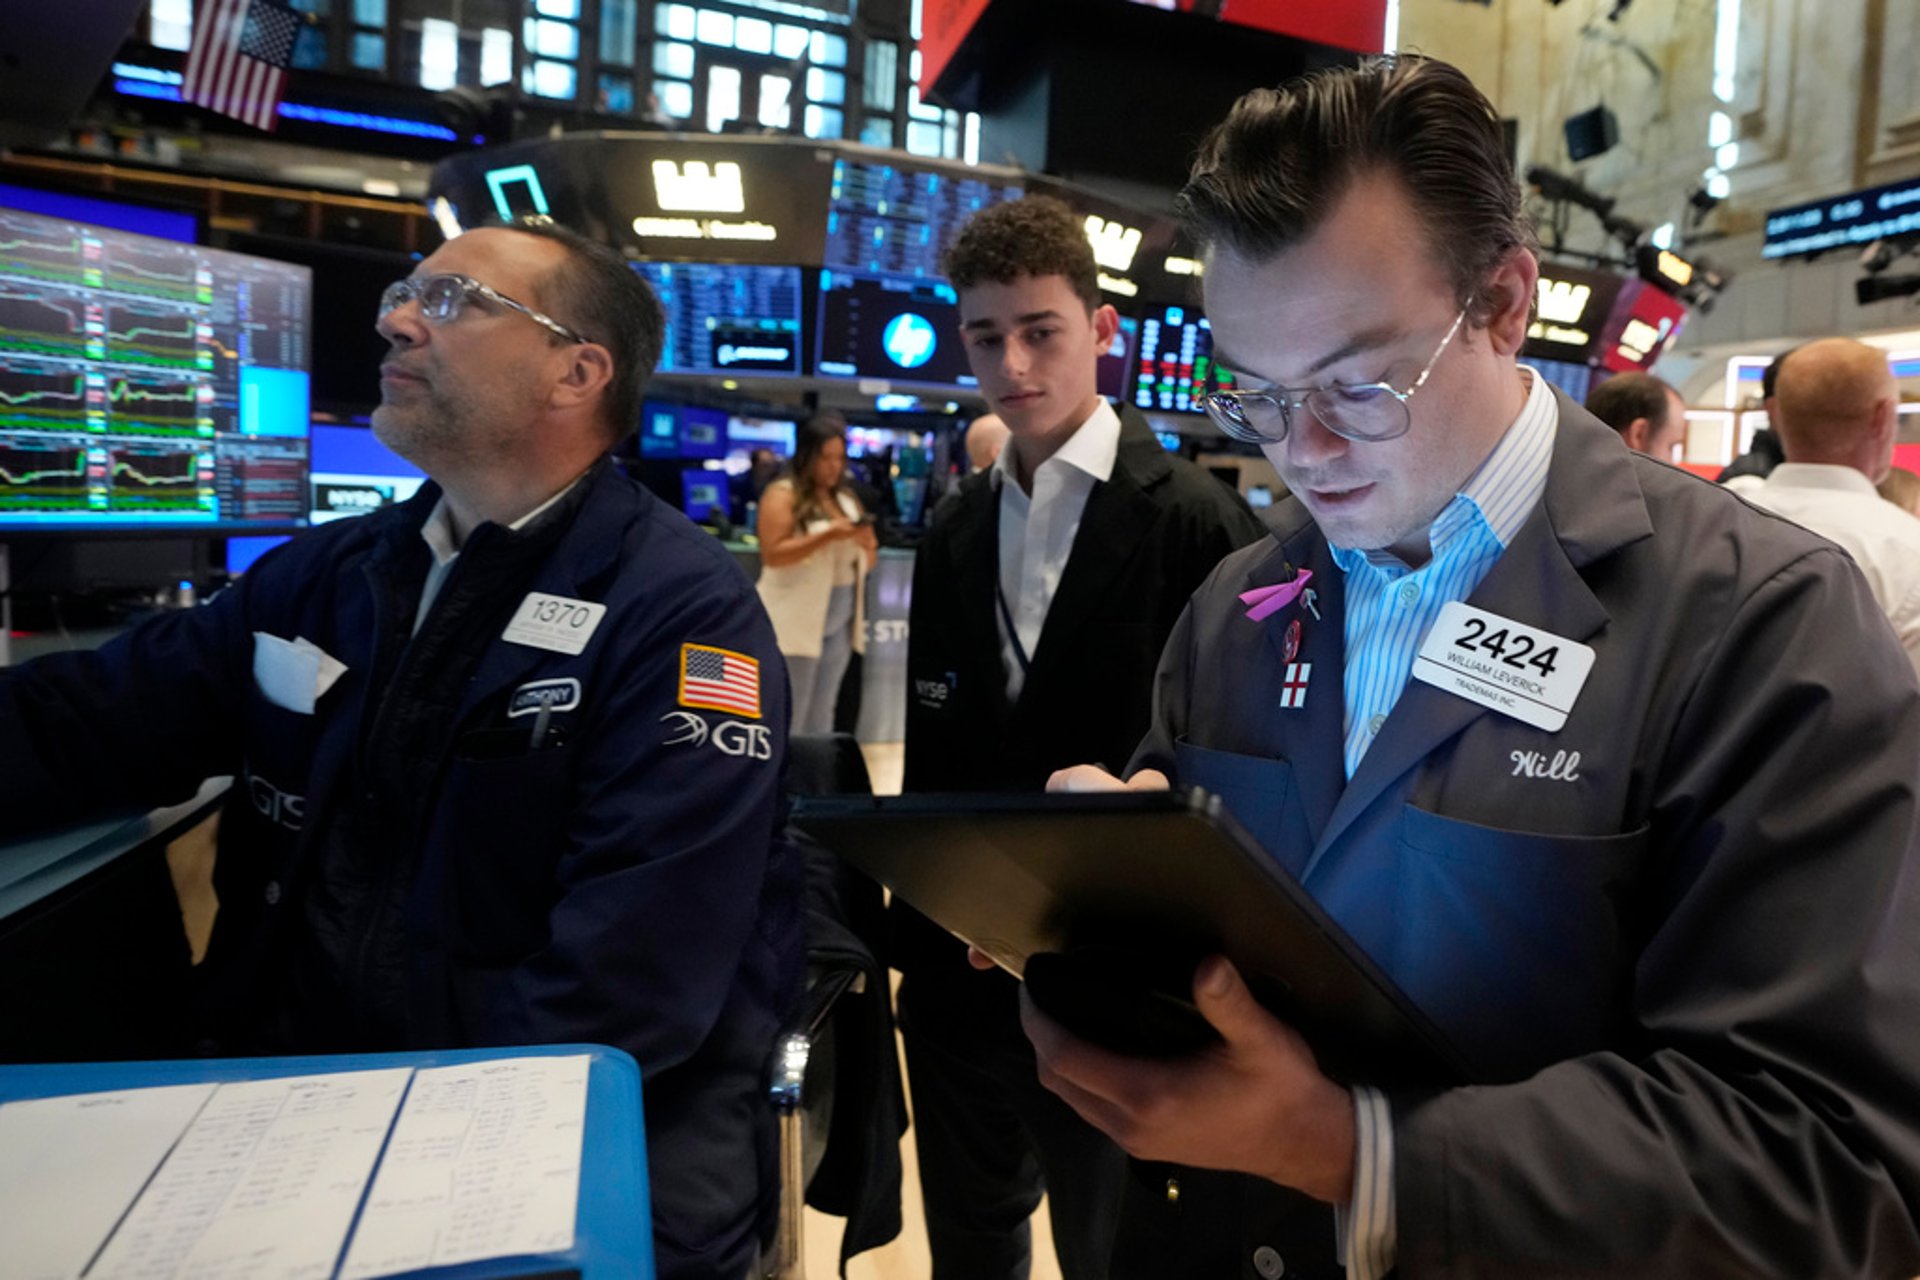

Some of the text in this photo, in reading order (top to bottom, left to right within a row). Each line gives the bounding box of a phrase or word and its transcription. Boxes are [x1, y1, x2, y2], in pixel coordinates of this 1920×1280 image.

[532, 599, 590, 628] 1370
[874, 619, 910, 643] ST
[1454, 618, 1560, 678] 2424
[1447, 651, 1547, 697] WILLIAM LEVERICK
[1455, 677, 1500, 701] TRADEMAS
[711, 720, 771, 761] GTS
[1510, 749, 1581, 782] Will
[248, 775, 305, 831] GTS
